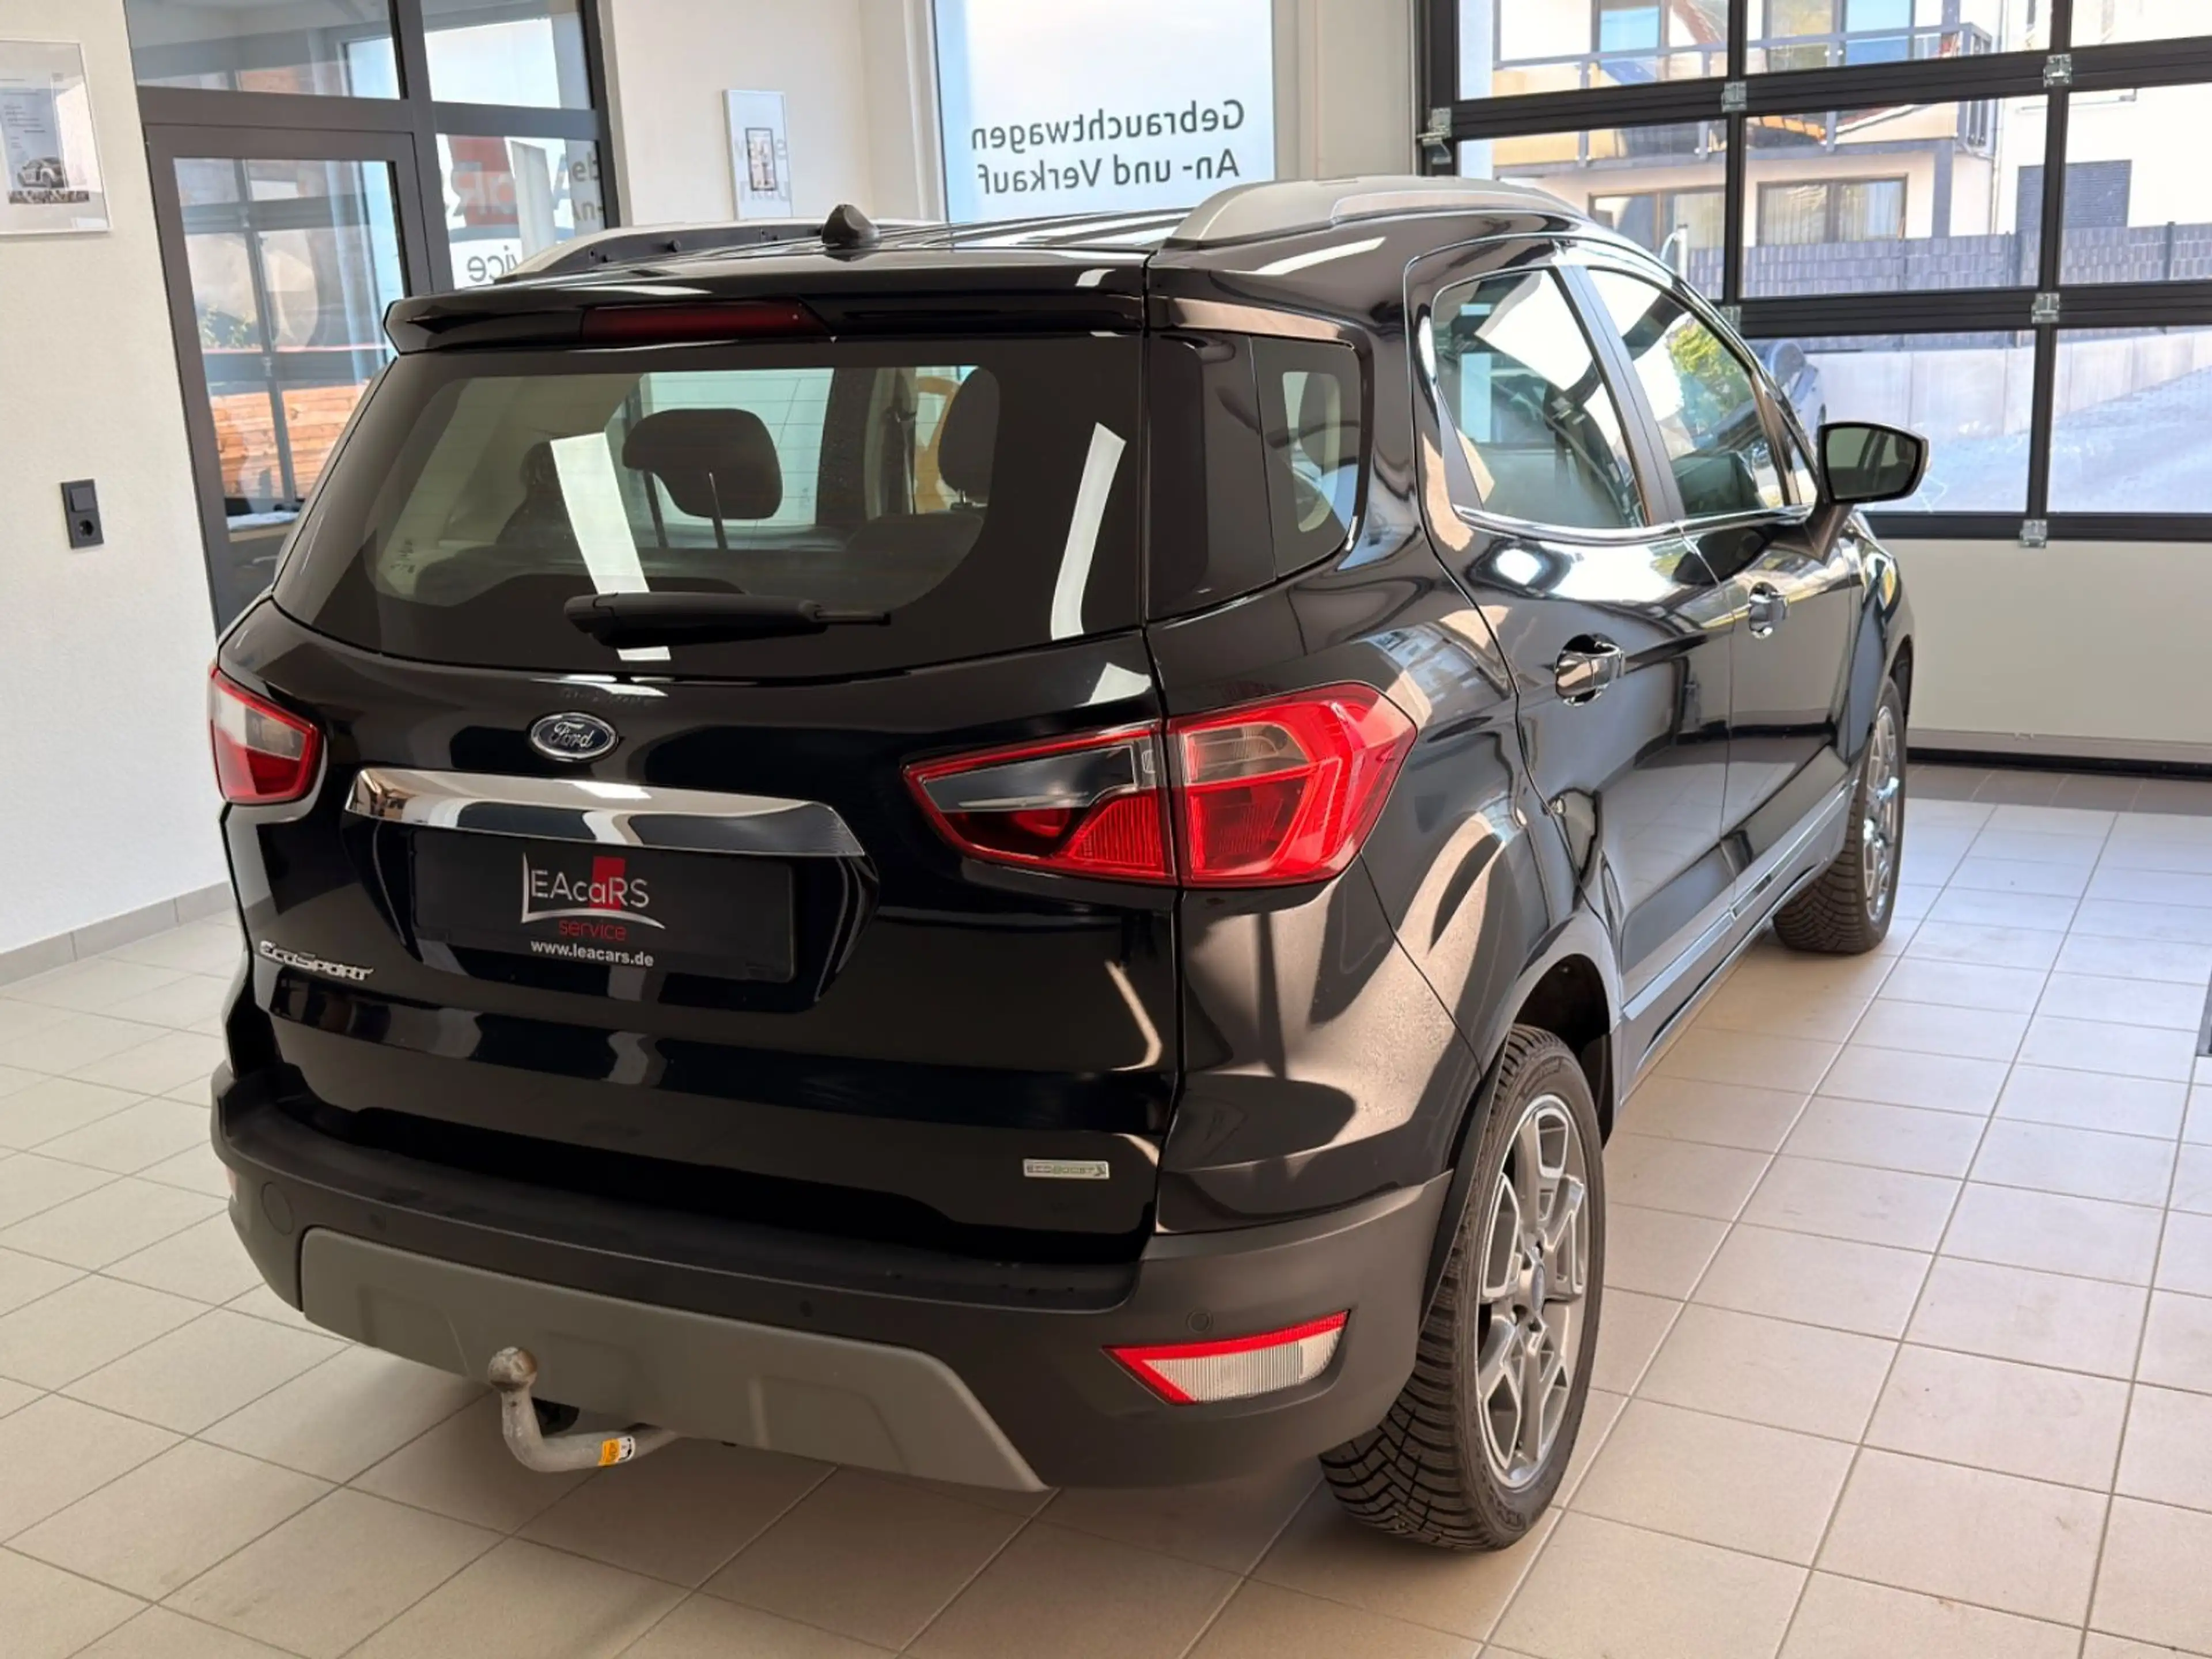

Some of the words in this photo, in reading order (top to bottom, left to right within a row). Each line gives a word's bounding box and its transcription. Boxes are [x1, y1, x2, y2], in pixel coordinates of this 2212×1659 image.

[549, 721, 596, 748] Ford
[558, 919, 627, 941] service
[530, 940, 654, 967] www.leacars.de
